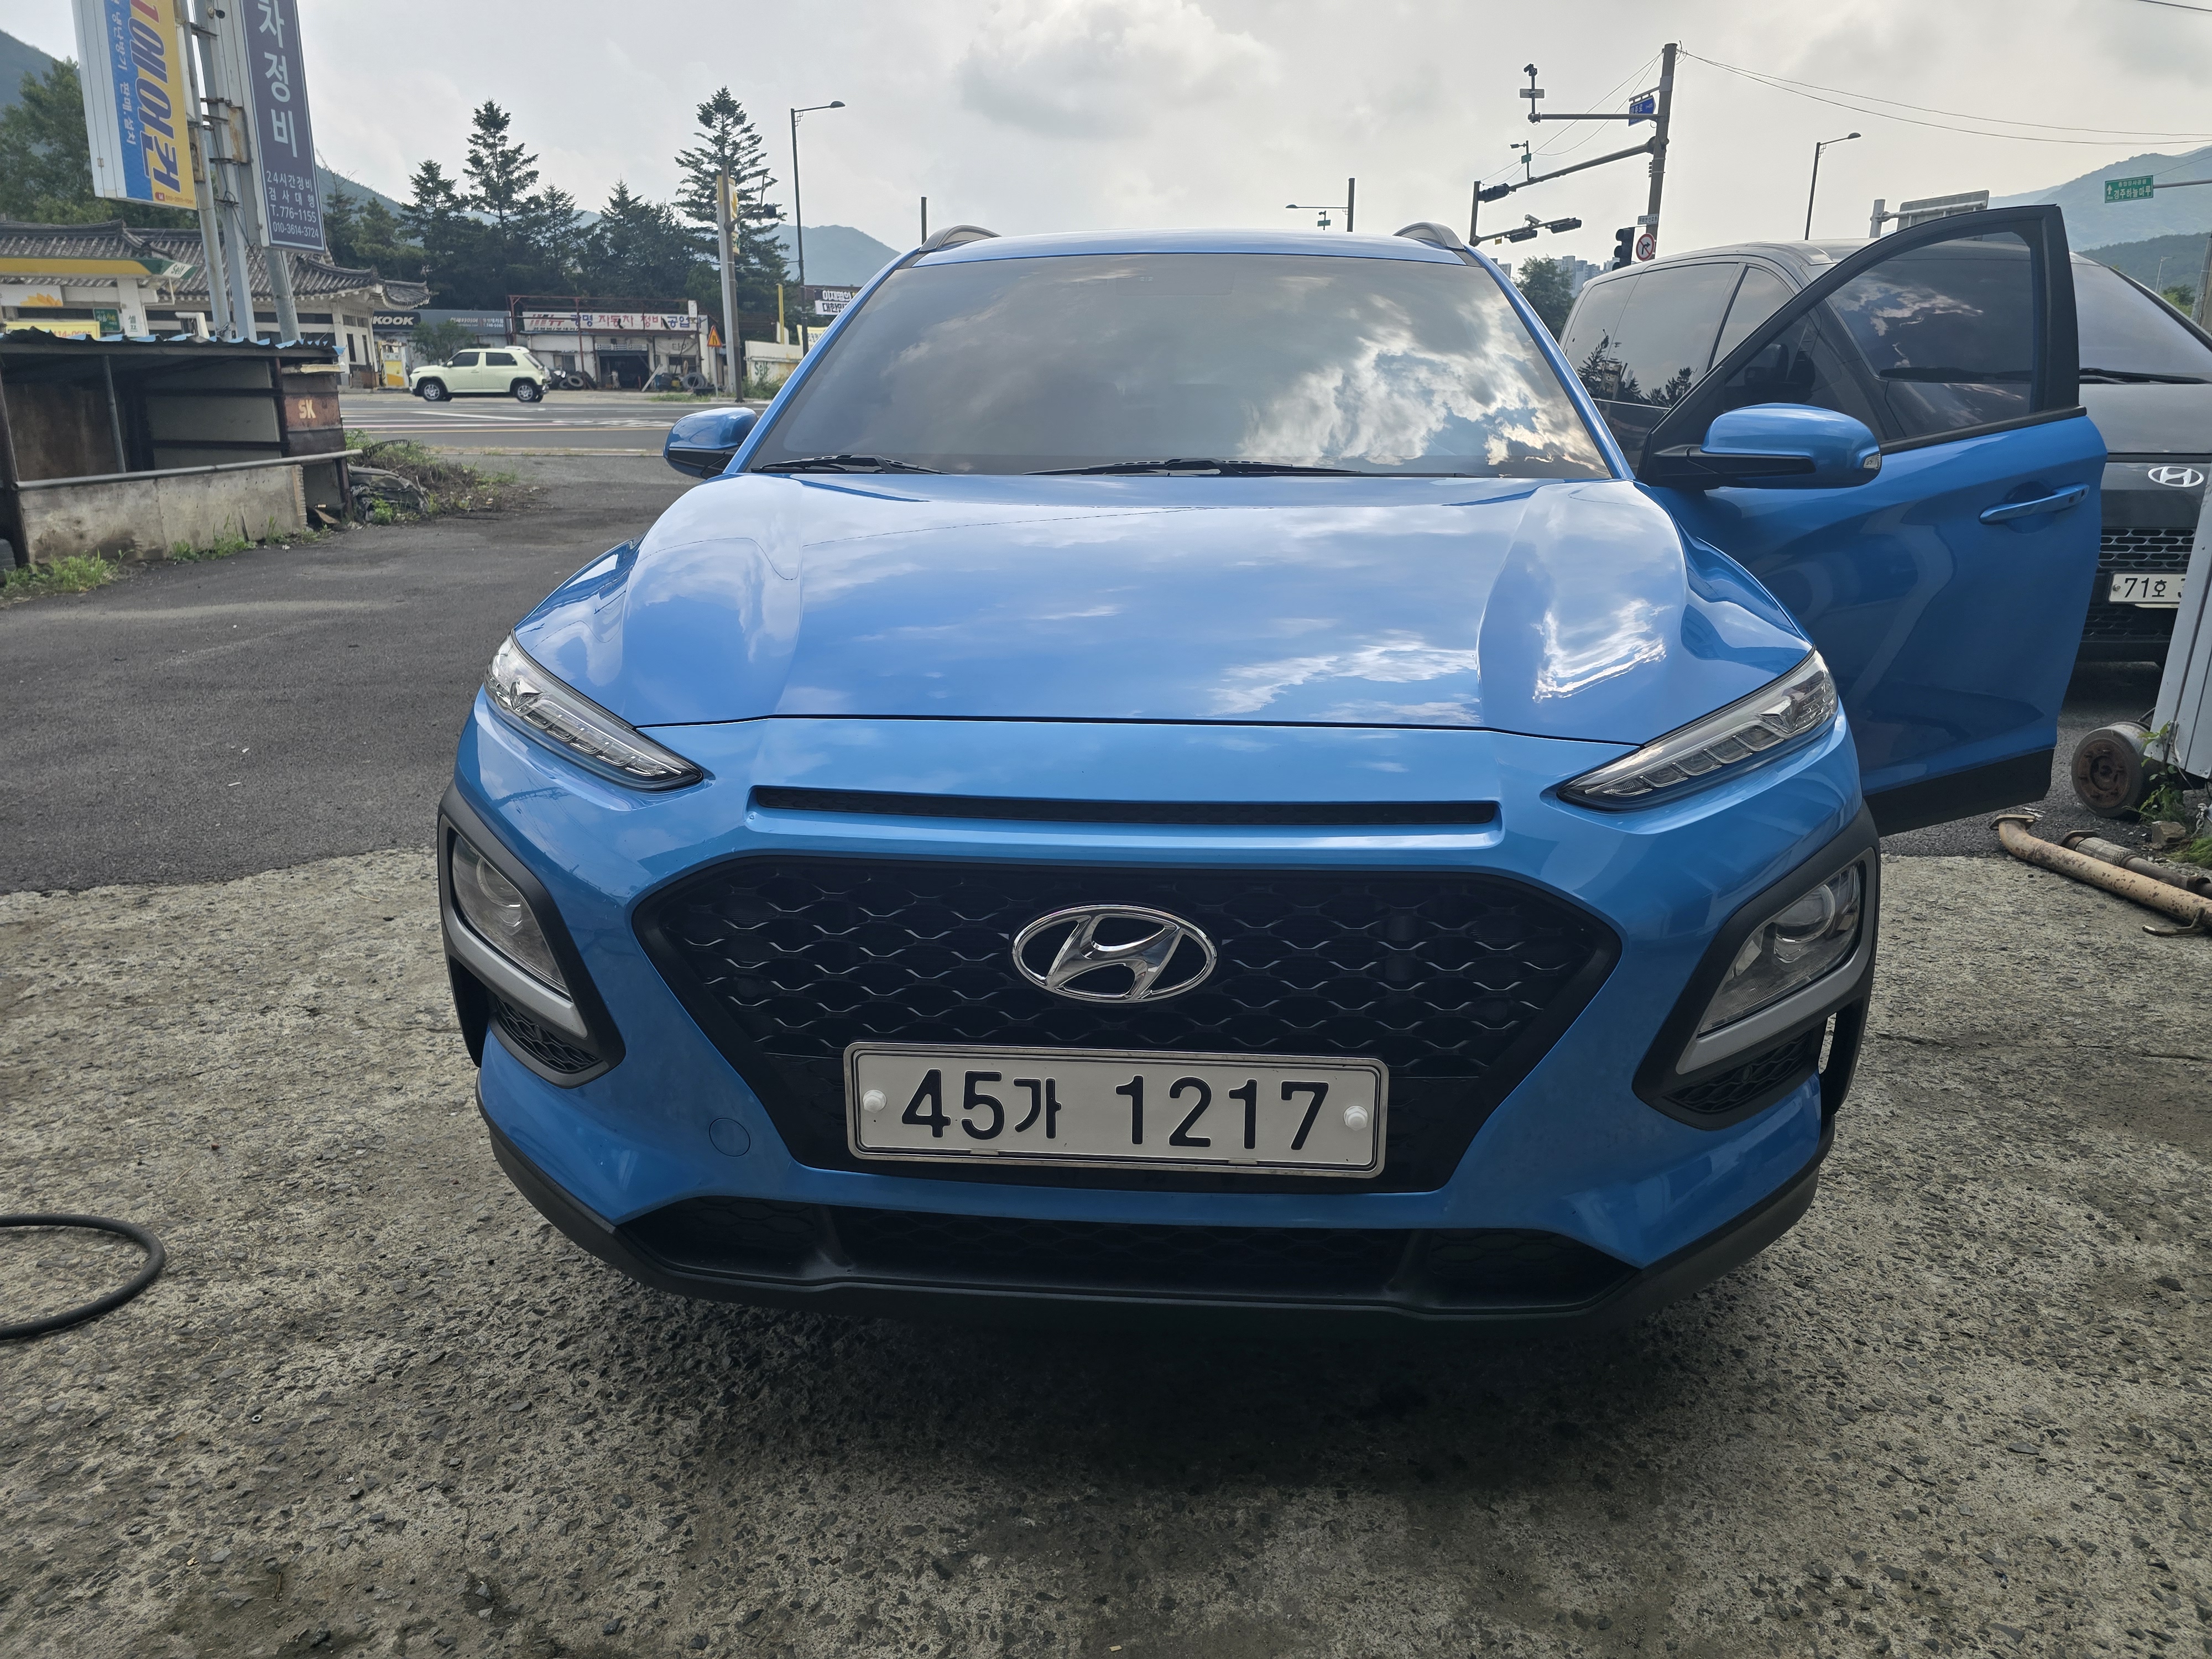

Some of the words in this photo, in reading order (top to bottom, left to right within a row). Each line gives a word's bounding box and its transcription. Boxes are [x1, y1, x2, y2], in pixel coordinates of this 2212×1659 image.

[112, 12, 128, 70] 냉난방기
[120, 82, 136, 144] 판매.설치
[2114, 185, 2151, 200] 경주하늘마루
[270, 204, 317, 223] T.776-1155
[273, 221, 319, 238] 010-3614-3724
[171, 264, 186, 275] Self
[822, 290, 852, 301] 이재명의
[822, 302, 848, 312] 대한민
[373, 316, 414, 325] KOOK
[599, 315, 634, 327] 자동차
[299, 399, 316, 419] SK
[2125, 578, 2167, 598] 71호
[901, 1069, 1061, 1140] 45가
[1115, 1075, 1329, 1150] 1217
